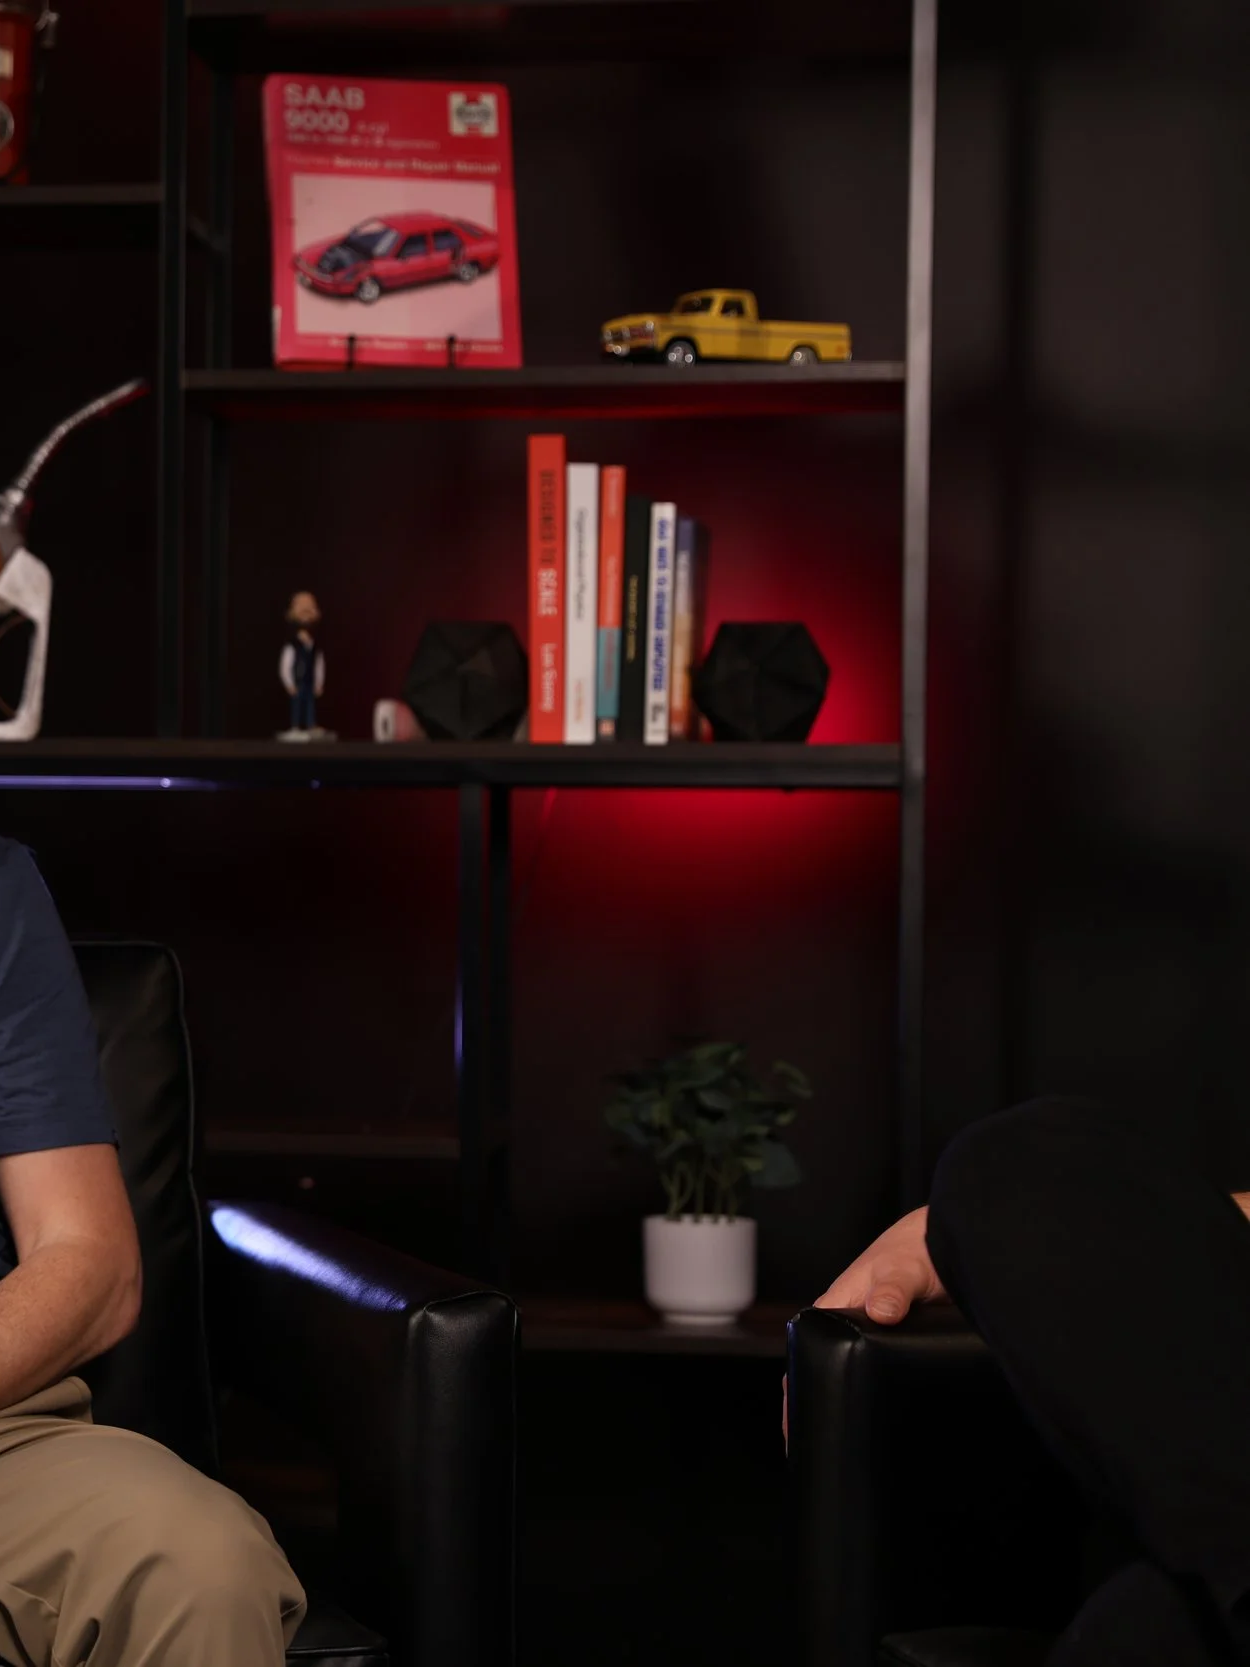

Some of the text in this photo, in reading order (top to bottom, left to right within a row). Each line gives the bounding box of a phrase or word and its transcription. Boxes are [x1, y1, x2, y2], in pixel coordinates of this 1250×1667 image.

[284, 84, 365, 110] SAAB
[285, 109, 349, 132] 9000
[456, 161, 501, 173] Manual
[540, 470, 557, 541] DESIGNED
[538, 568, 558, 617] SCALE
